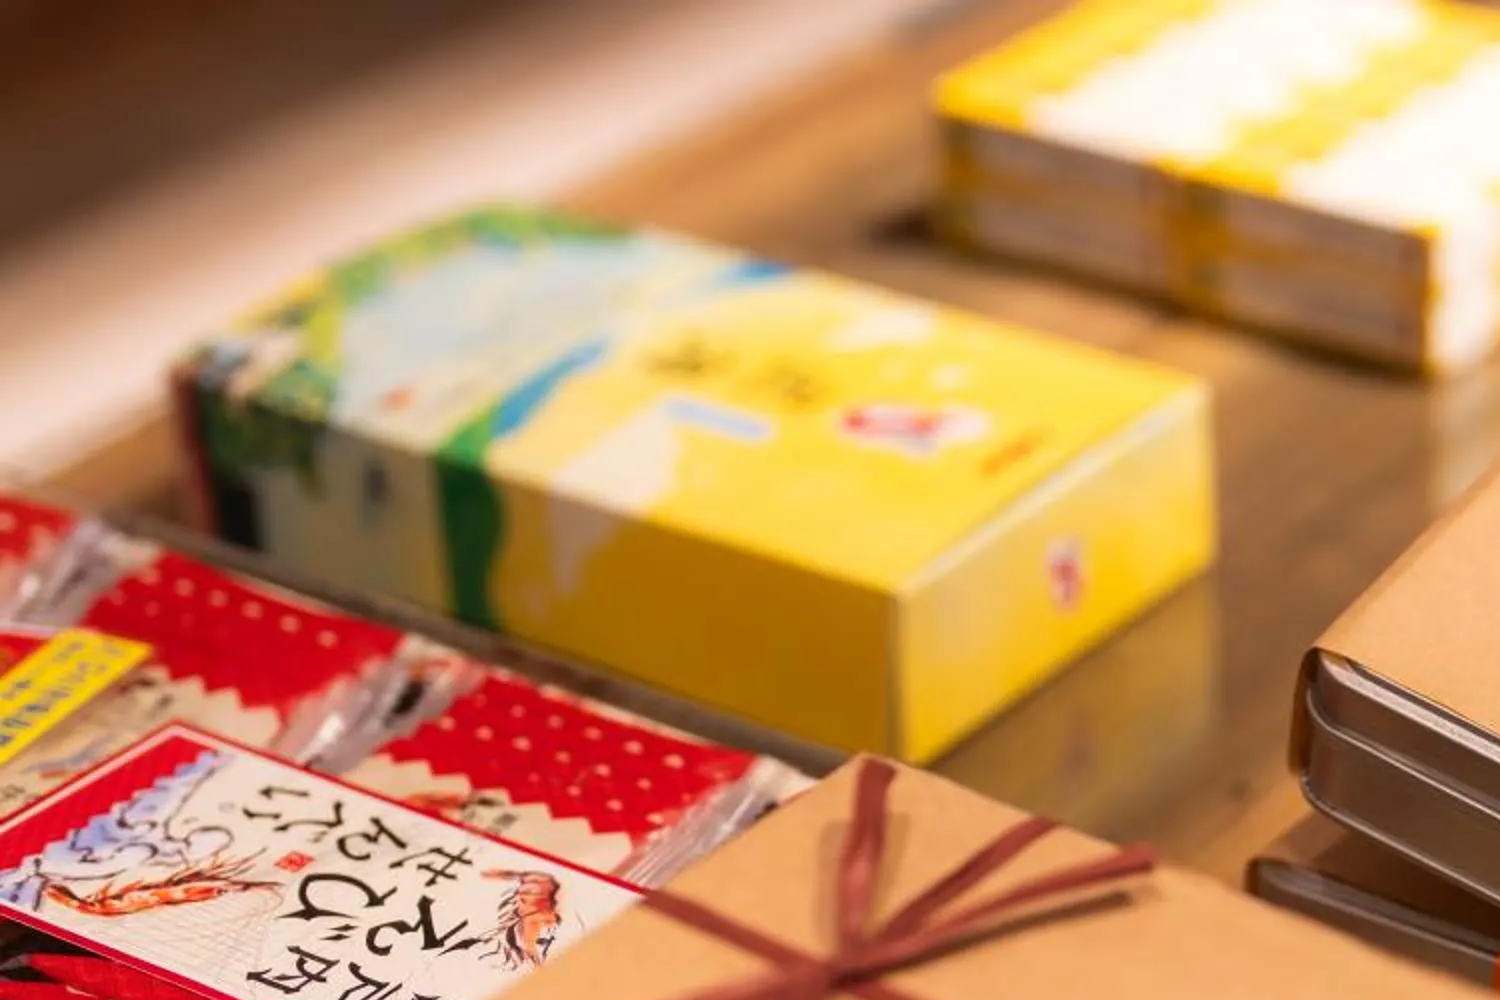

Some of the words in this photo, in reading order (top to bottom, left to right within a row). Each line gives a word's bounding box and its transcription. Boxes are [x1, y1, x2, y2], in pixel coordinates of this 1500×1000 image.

[242, 785, 473, 887] せんべい
[275, 873, 482, 957] えび
